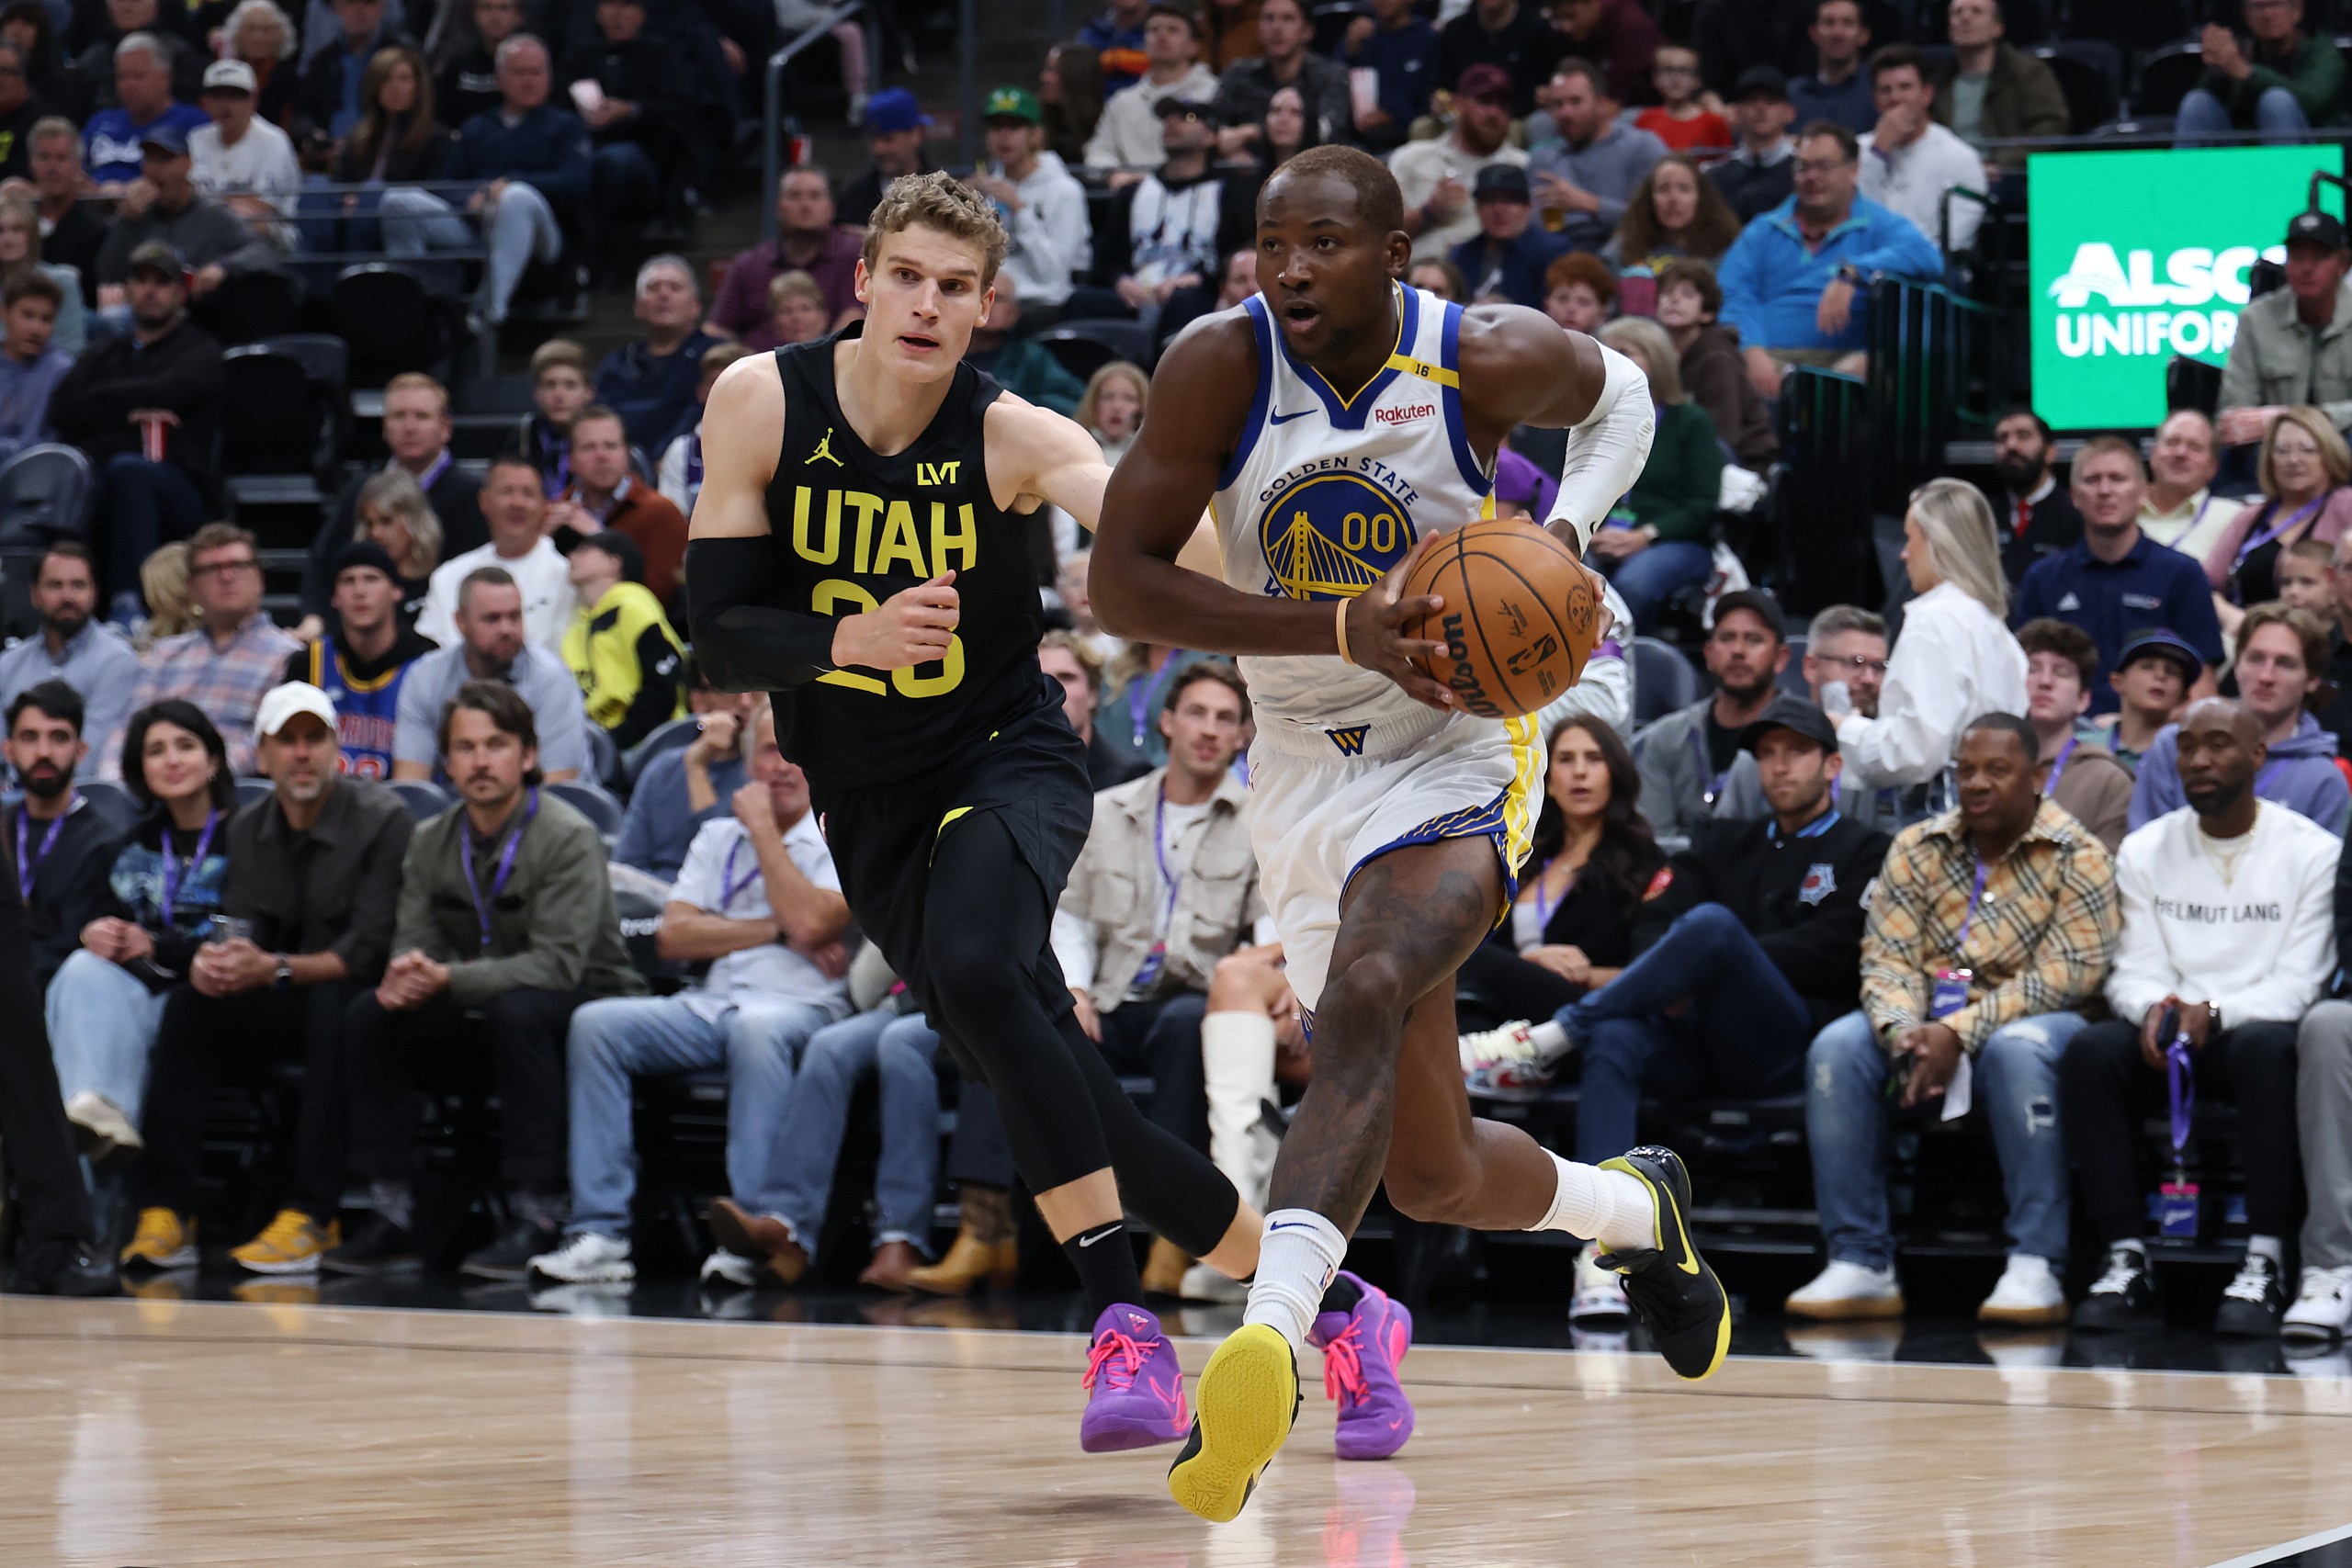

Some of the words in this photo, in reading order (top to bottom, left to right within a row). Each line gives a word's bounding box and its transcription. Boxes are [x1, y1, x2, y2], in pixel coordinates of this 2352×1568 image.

[2047, 243, 2287, 307] ALSC
[2056, 310, 2238, 356] UNIFOR
[1415, 364, 1430, 377] 16
[1375, 404, 1435, 425] Rakuten
[917, 461, 960, 486] LVT
[1260, 457, 1348, 502] GOLDEN
[1359, 457, 1419, 506] STATE
[793, 485, 977, 579] UTAH
[1342, 512, 1396, 553] 00
[2153, 895, 2227, 924] HELMUT
[2233, 901, 2280, 923] LANG
